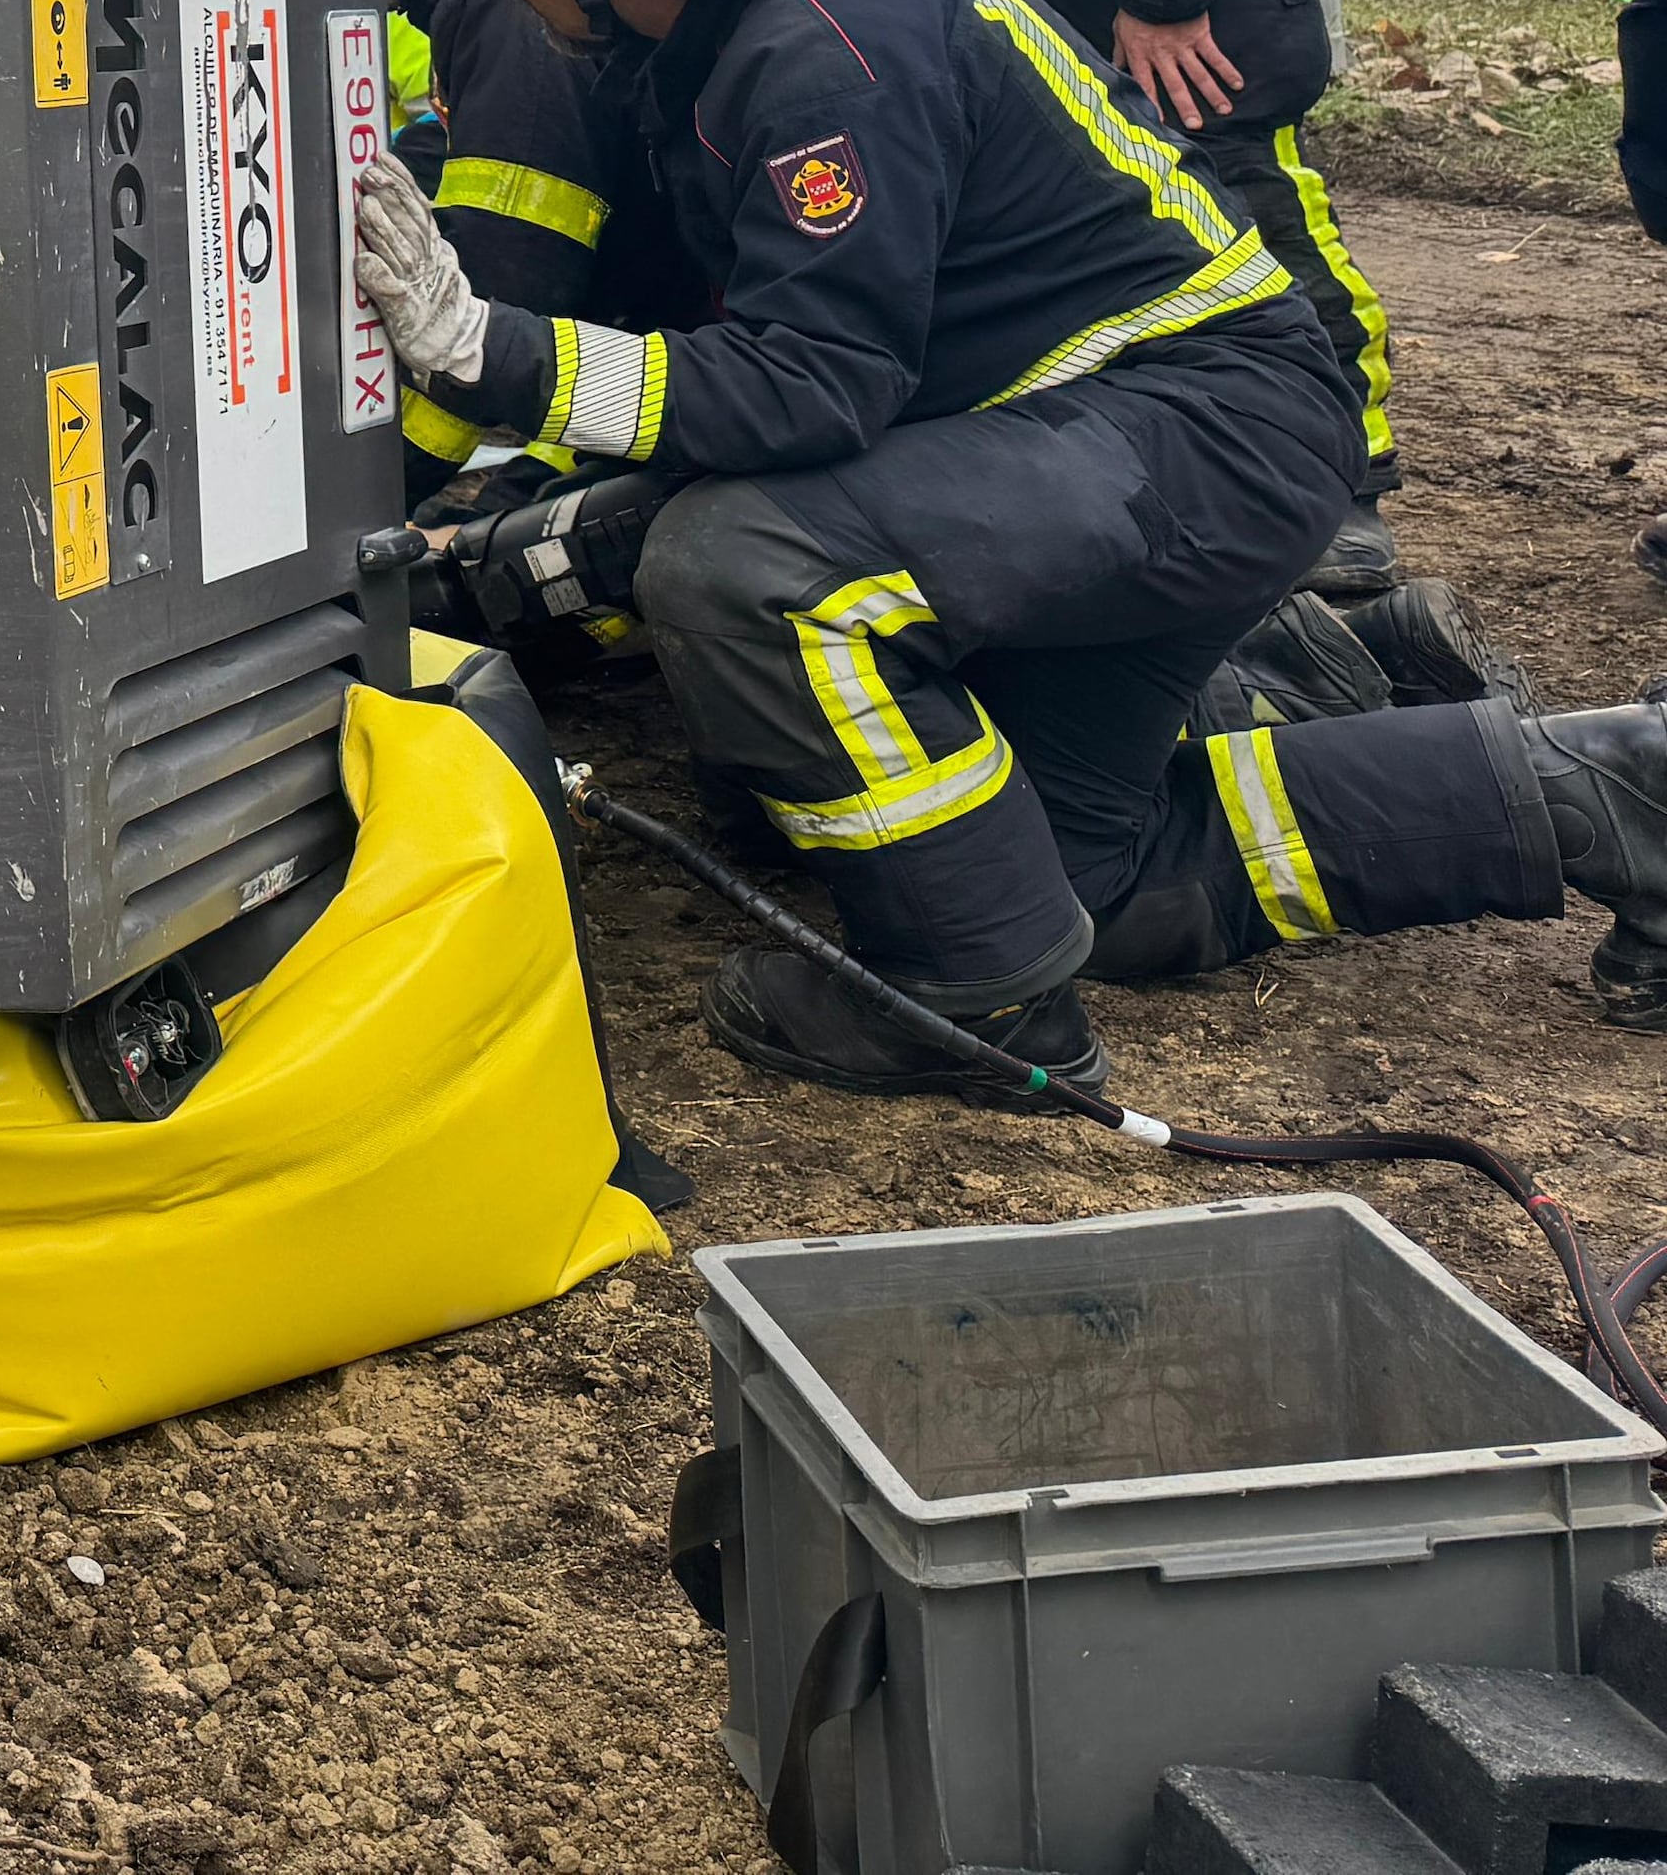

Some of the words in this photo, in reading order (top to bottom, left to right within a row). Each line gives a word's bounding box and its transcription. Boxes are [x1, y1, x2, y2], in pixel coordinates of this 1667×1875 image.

[208, 150, 223, 281] MAQUINARIA
[343, 29, 385, 411] E96HX
[216, 328, 227, 360] 354
[218, 366, 228, 387] 71
[219, 395, 229, 416] 71
